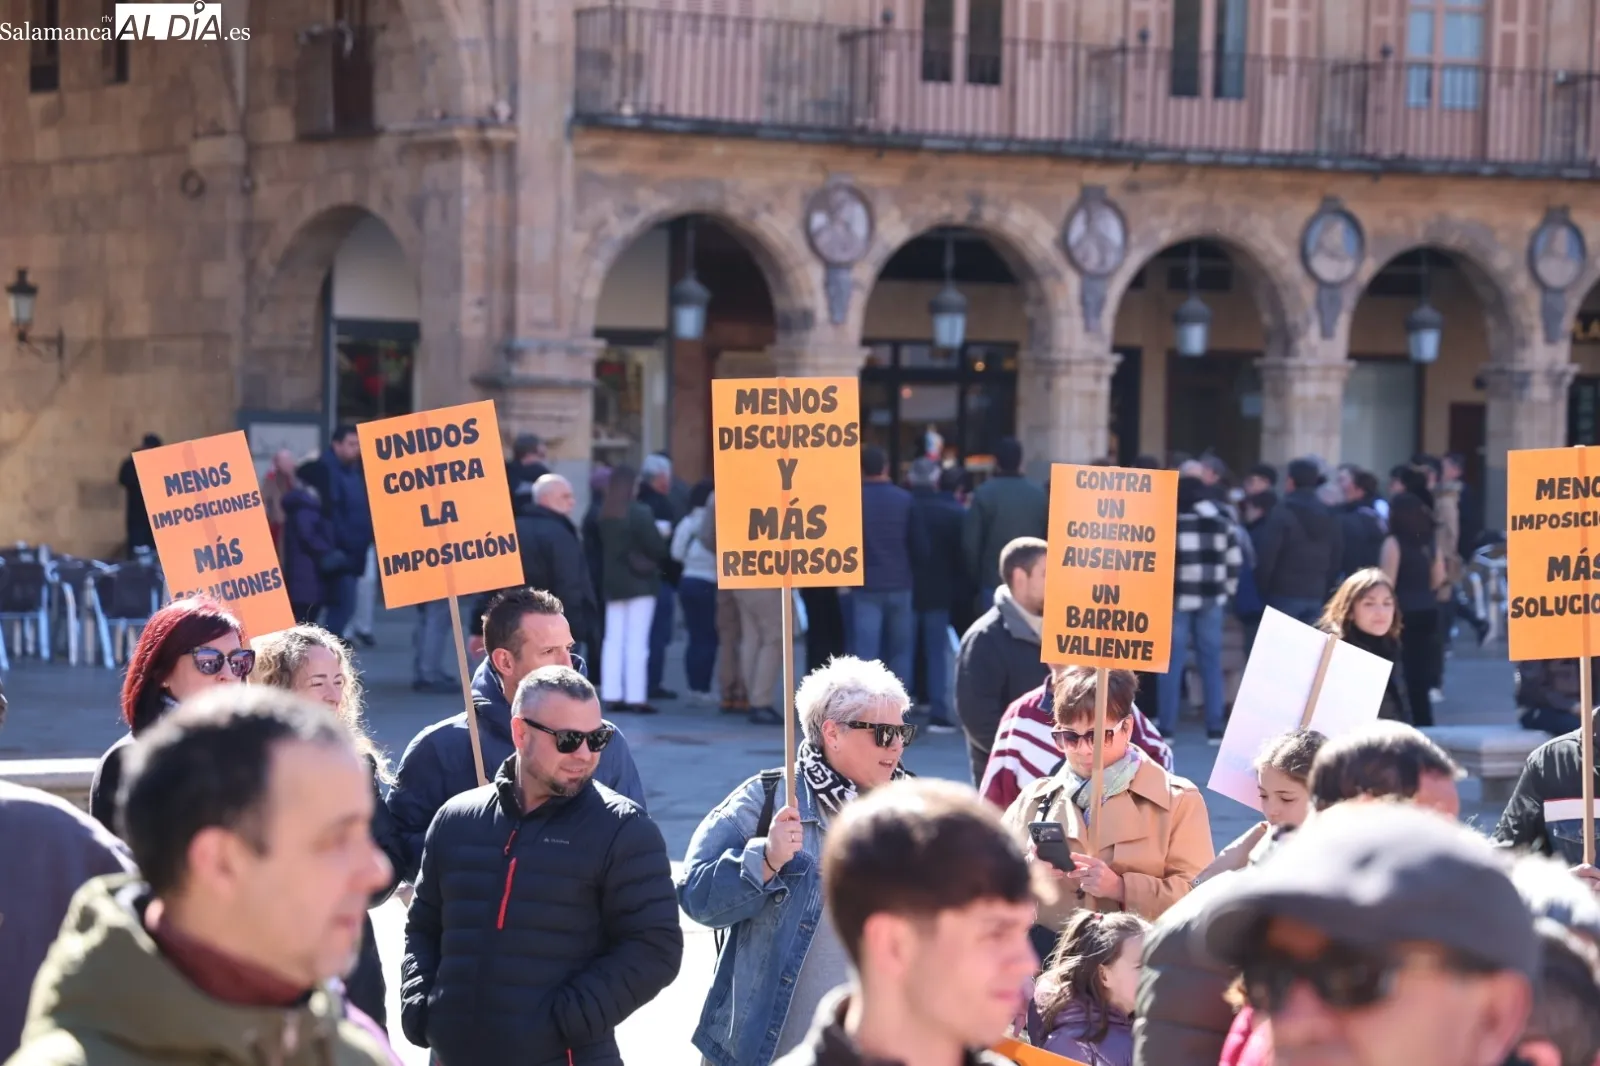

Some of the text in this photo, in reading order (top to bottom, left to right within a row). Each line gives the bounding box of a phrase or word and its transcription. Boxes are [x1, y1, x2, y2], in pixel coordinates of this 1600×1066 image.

[735, 385, 838, 415] MENOS
[375, 418, 479, 460] UNIDOS
[718, 422, 858, 450] DISCURSOS
[163, 462, 231, 497] MENOS
[383, 458, 485, 494] CONTRA
[777, 458, 798, 490] Y
[1076, 470, 1152, 493] CONTRA
[152, 490, 261, 530] IMPOSICIONES
[420, 500, 458, 527] LA
[748, 497, 827, 540] MÁS
[1097, 498, 1125, 519] UN
[1511, 511, 1600, 531] IMPOSICI
[1067, 521, 1156, 543] GOBIERNO
[193, 535, 243, 574] MÁS
[383, 531, 517, 576] IMPOSICIÓN
[722, 546, 858, 576] RECURSOS
[1062, 546, 1156, 572] AUSENTE
[1092, 584, 1120, 604] UN
[1066, 605, 1149, 633] BARRIO
[1056, 634, 1154, 661] VALIENTE
